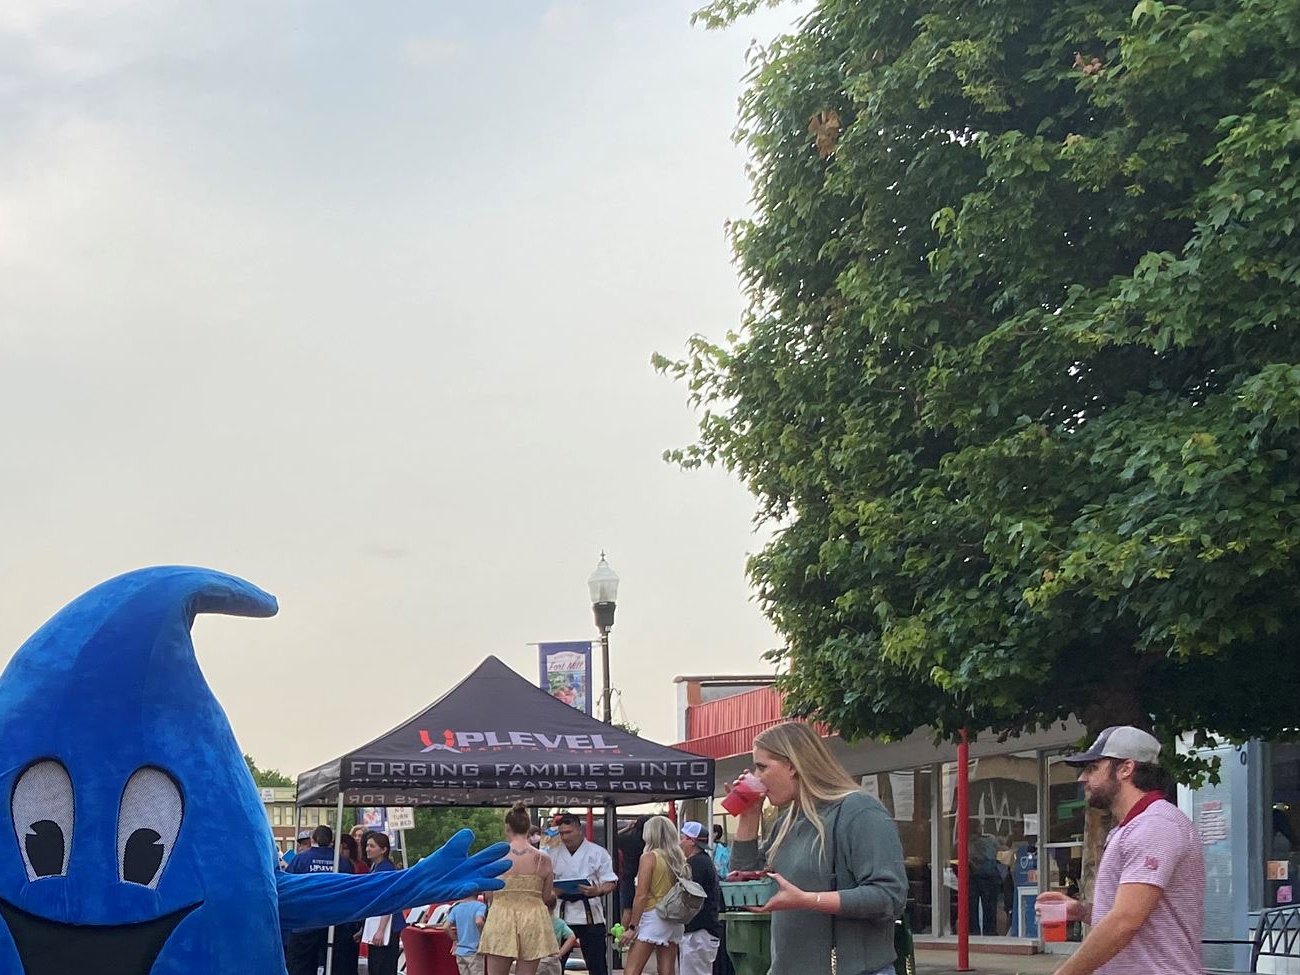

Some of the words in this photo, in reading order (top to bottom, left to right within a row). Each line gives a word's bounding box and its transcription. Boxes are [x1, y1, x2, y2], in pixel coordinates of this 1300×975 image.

[549, 661, 565, 671] Fort
[567, 661, 583, 670] Mill
[419, 729, 619, 753] UPLEVEL
[350, 761, 479, 776] FORGING
[495, 763, 624, 777] FAMILIES
[640, 762, 708, 776] INTO
[495, 780, 598, 792] LEADERS
[609, 780, 653, 791] FOR
[664, 780, 708, 791] LIFE
[310, 865, 333, 873] UPLEVE
